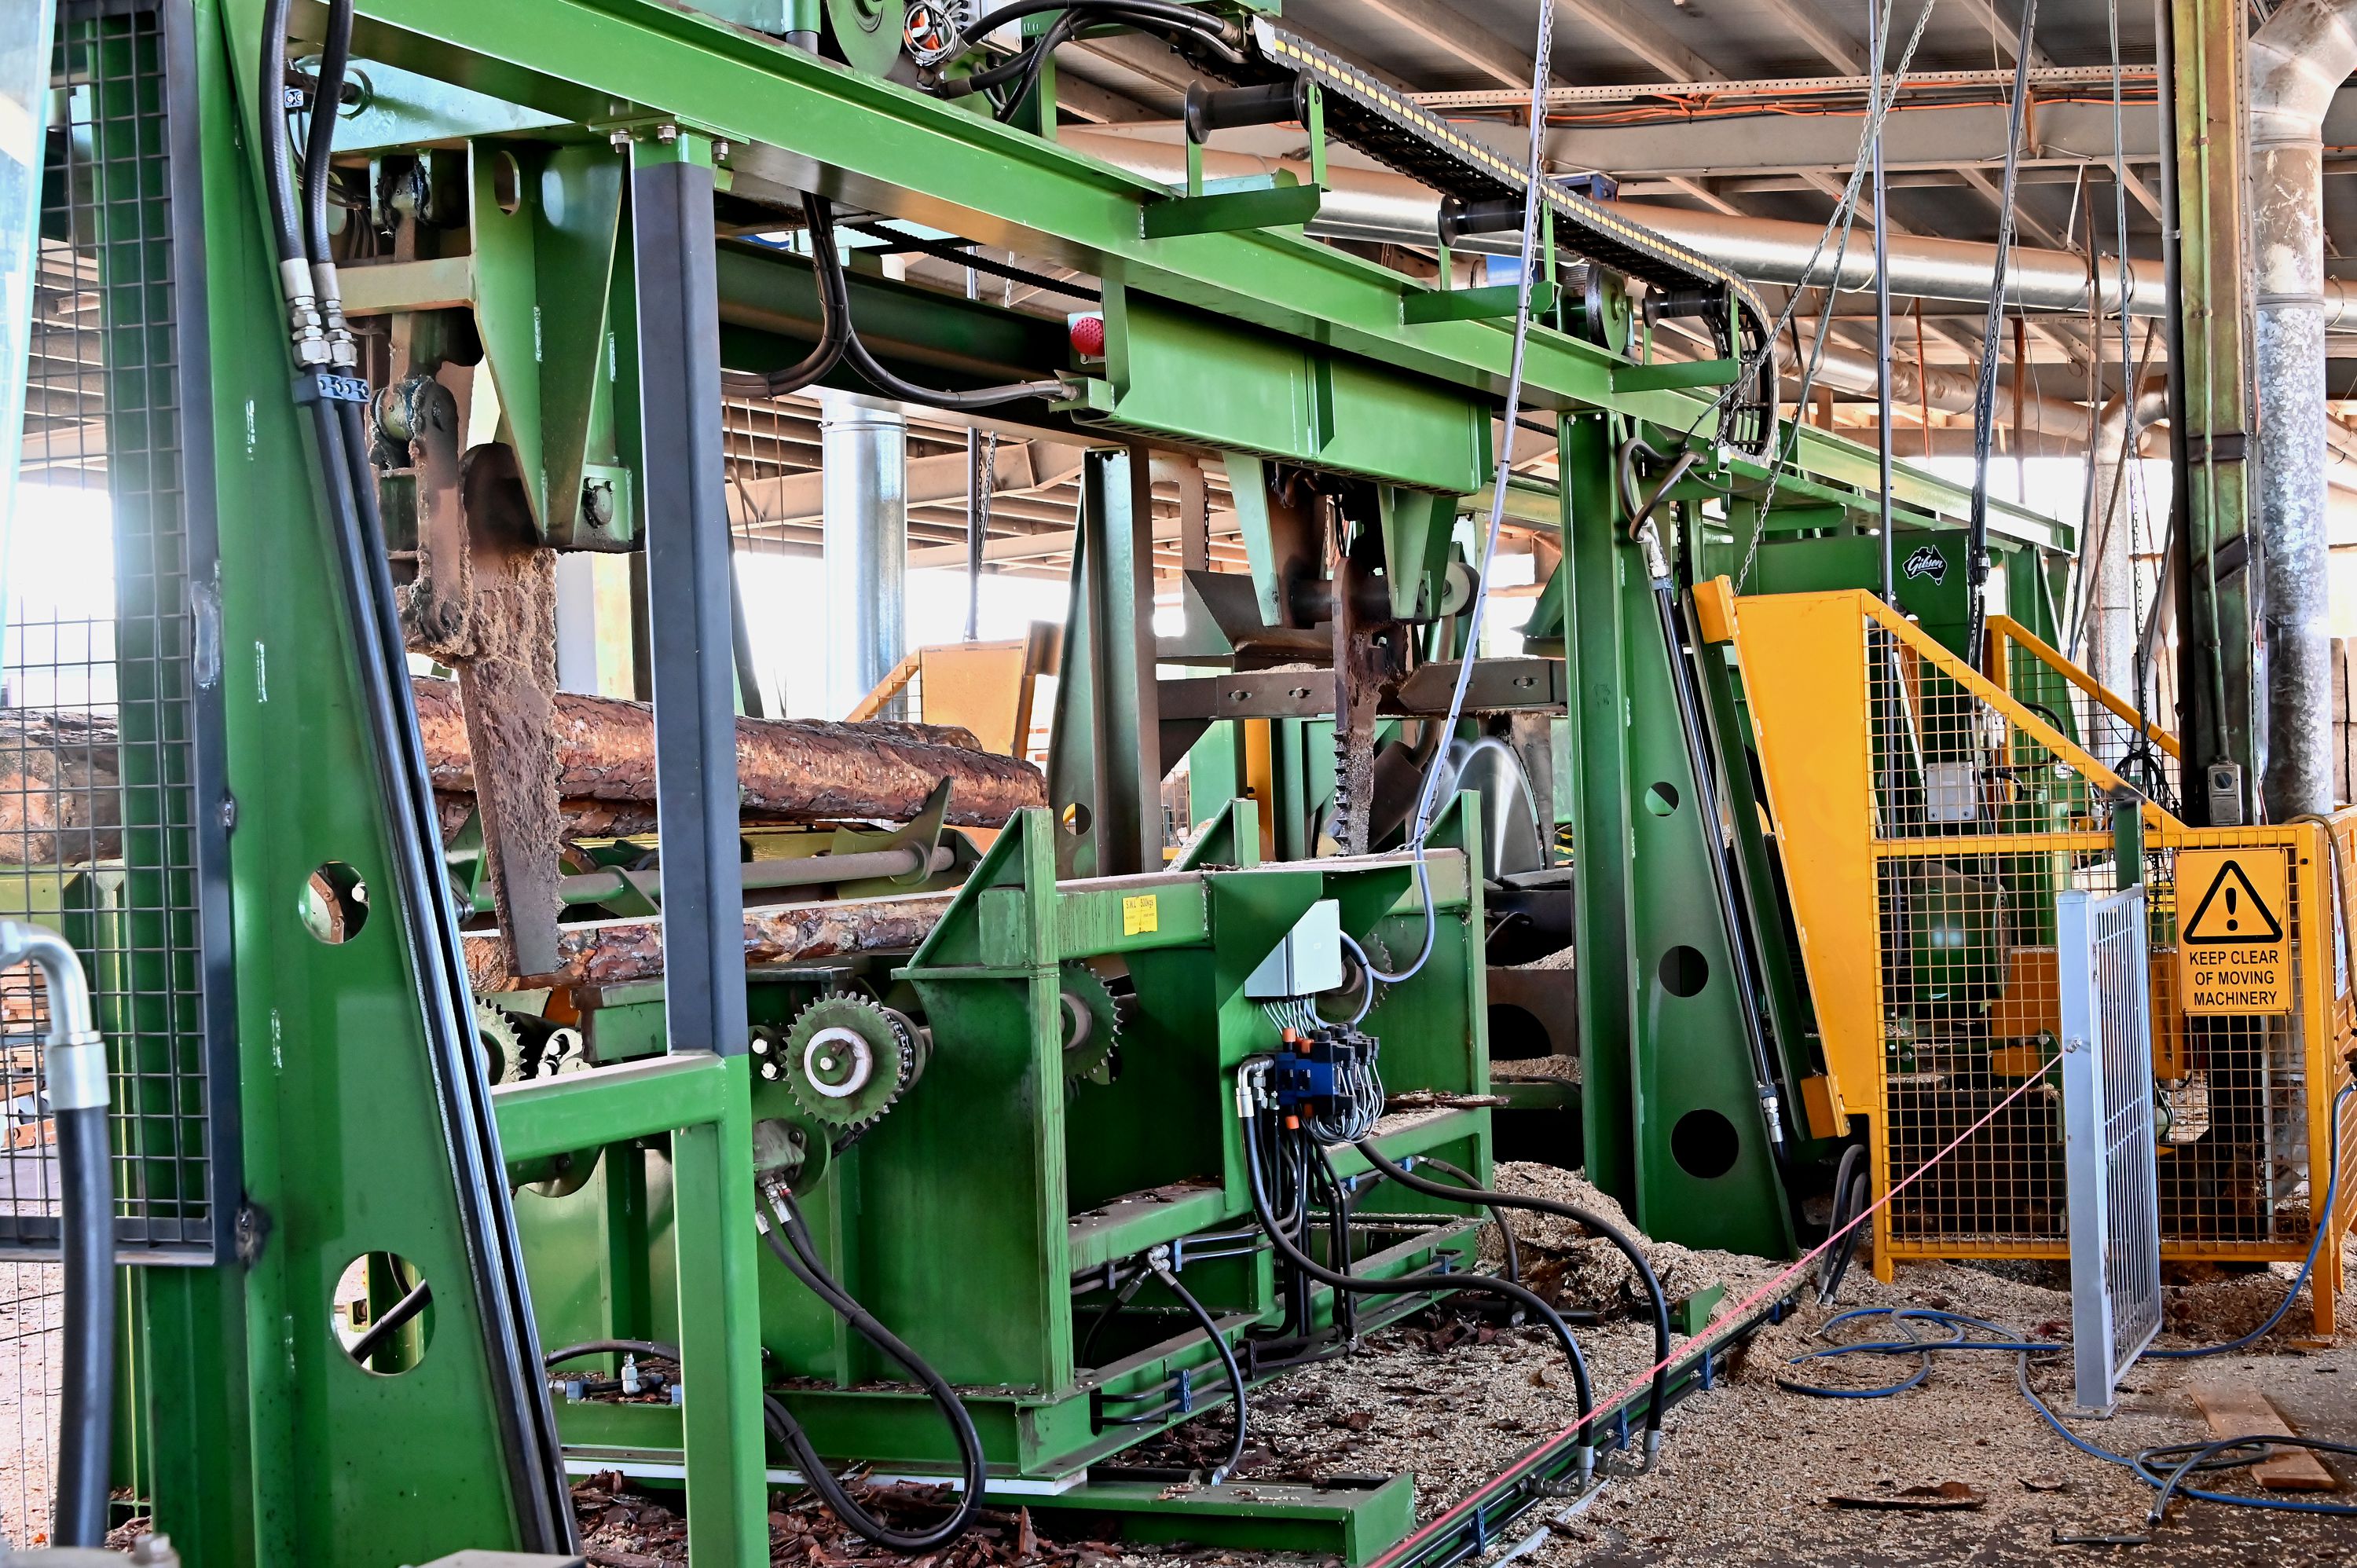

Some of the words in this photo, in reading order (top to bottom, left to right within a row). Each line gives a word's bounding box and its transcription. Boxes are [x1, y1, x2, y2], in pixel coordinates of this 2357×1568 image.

[1908, 555, 1944, 575] Gibson
[2190, 951, 2226, 965] KEEP
[2231, 950, 2278, 965] CLEAR
[2195, 972, 2213, 985] OF
[2218, 970, 2275, 985] MOVING
[2194, 991, 2277, 1006] MACHINERY
